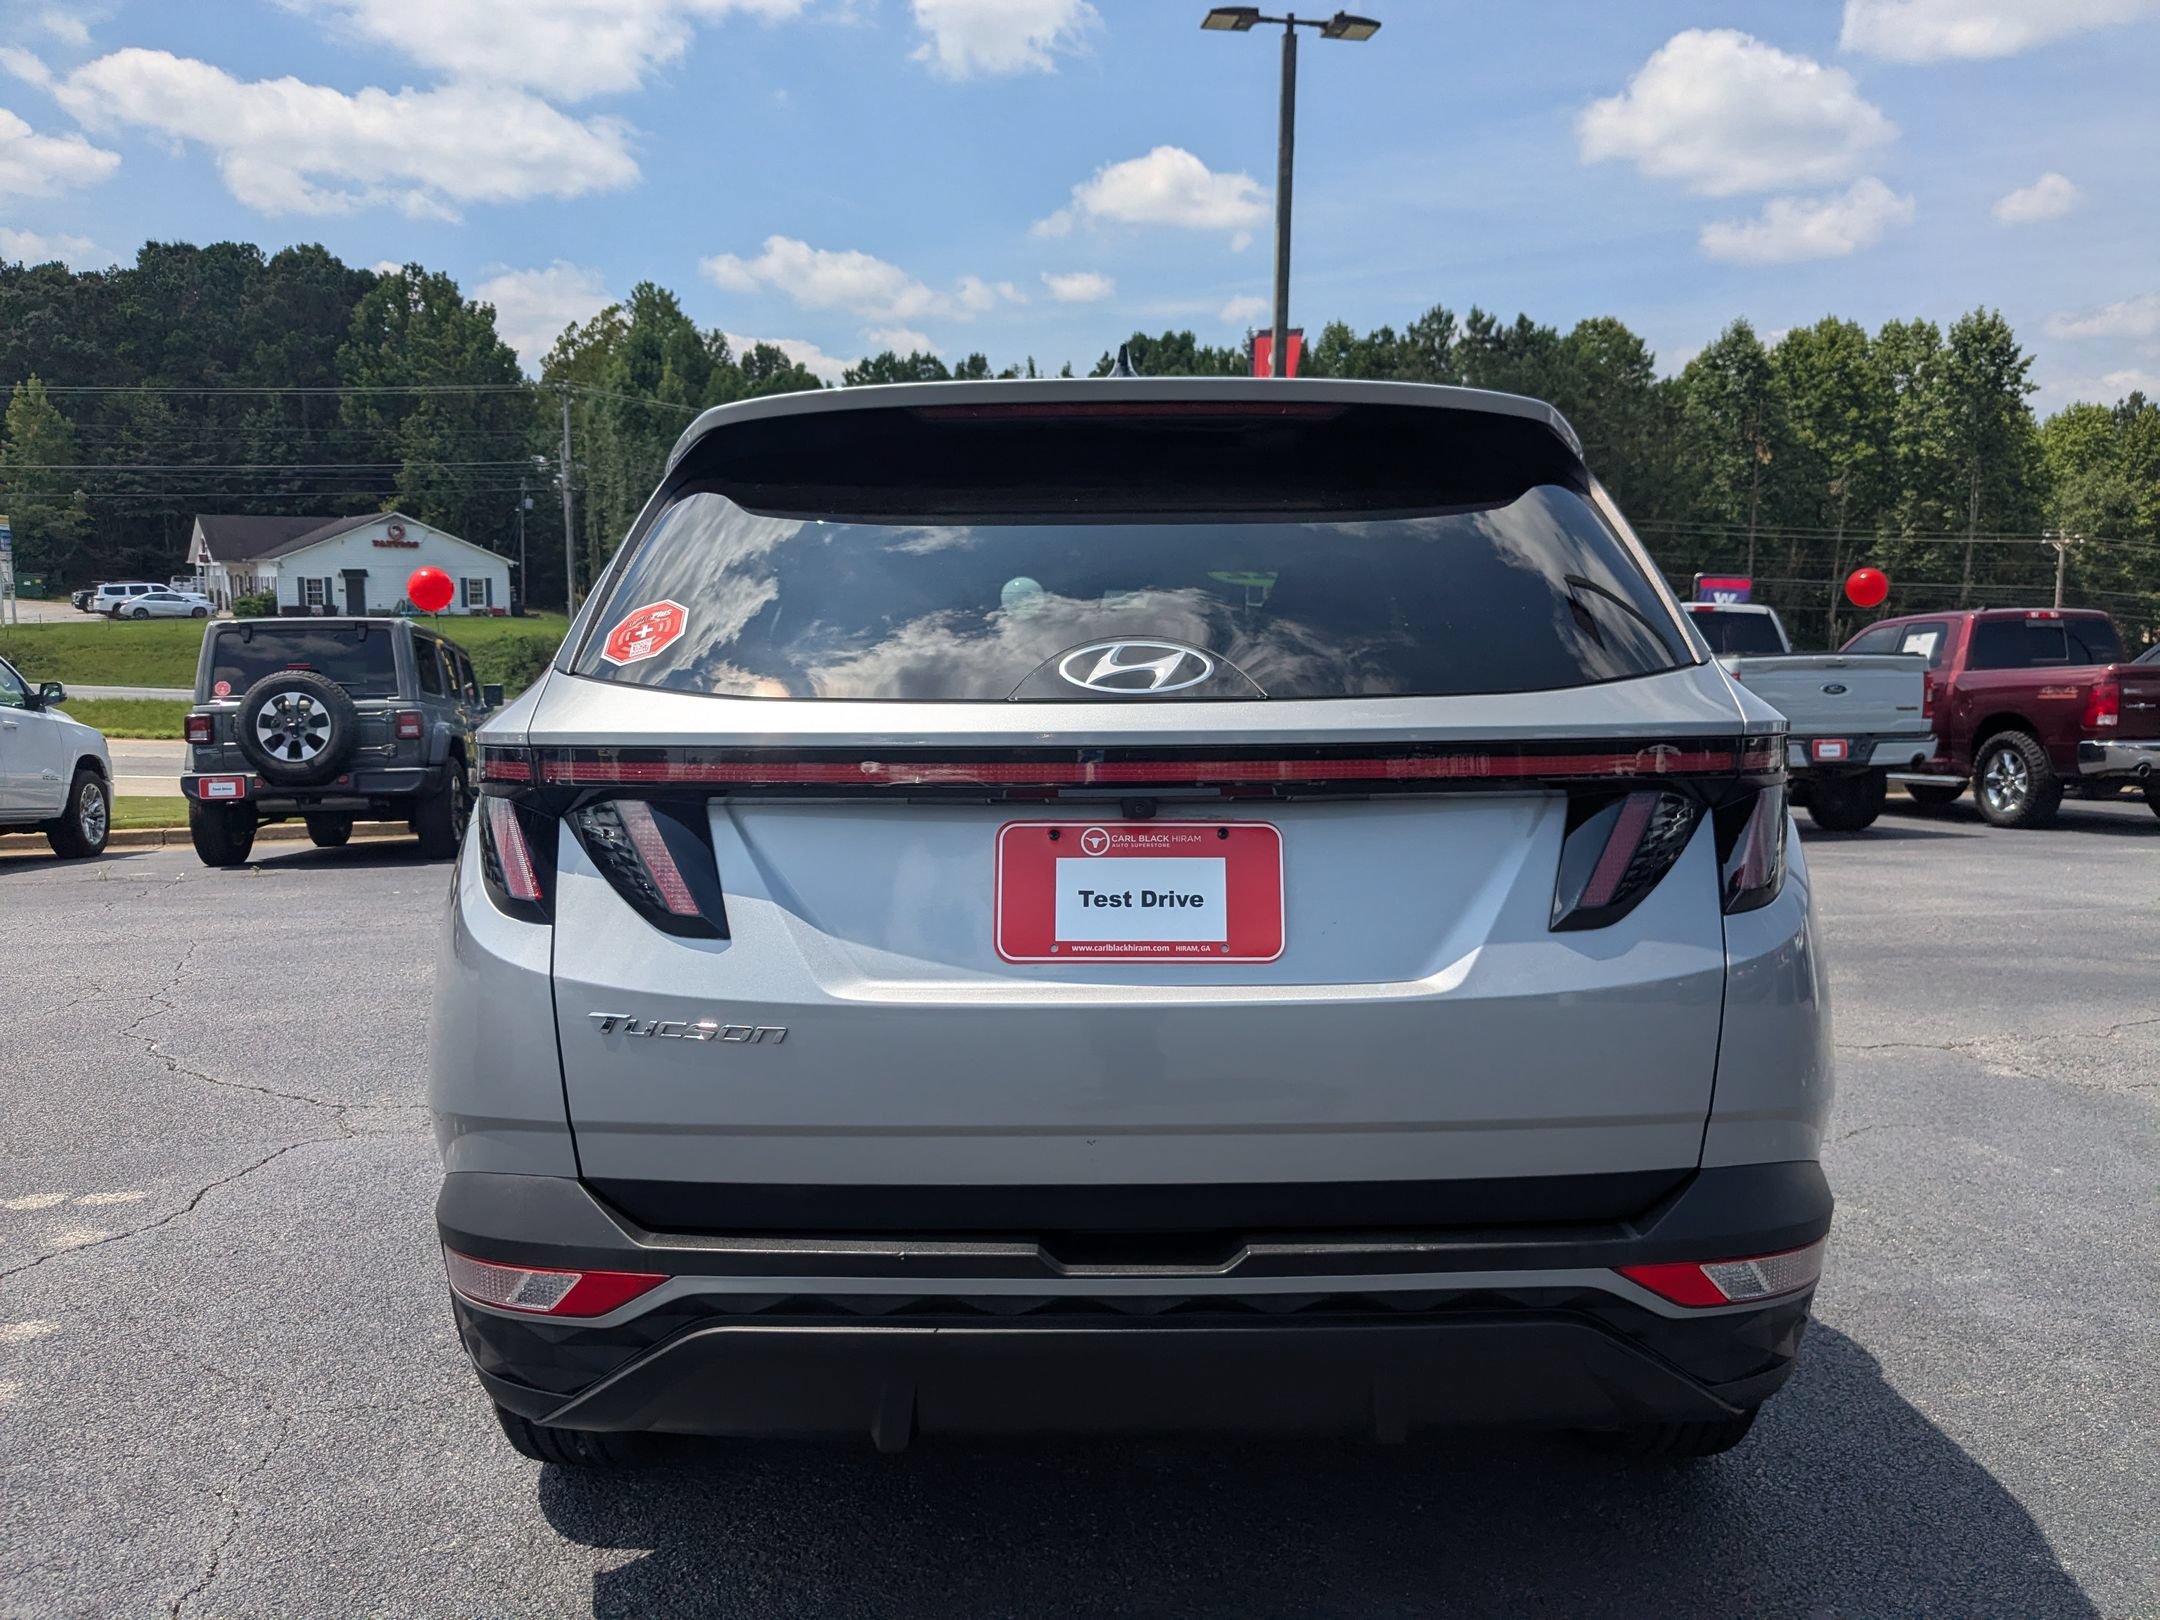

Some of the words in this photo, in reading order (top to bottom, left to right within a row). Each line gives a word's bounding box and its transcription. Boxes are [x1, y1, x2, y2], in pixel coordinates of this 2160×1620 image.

[1111, 834, 1136, 842] CARL
[1139, 834, 1169, 842] BLACK
[1171, 834, 1201, 842] HIRAM
[1078, 890, 1132, 908] Test
[1140, 890, 1204, 908] Drive
[1071, 944, 1170, 952] www.carlblackhiram.com
